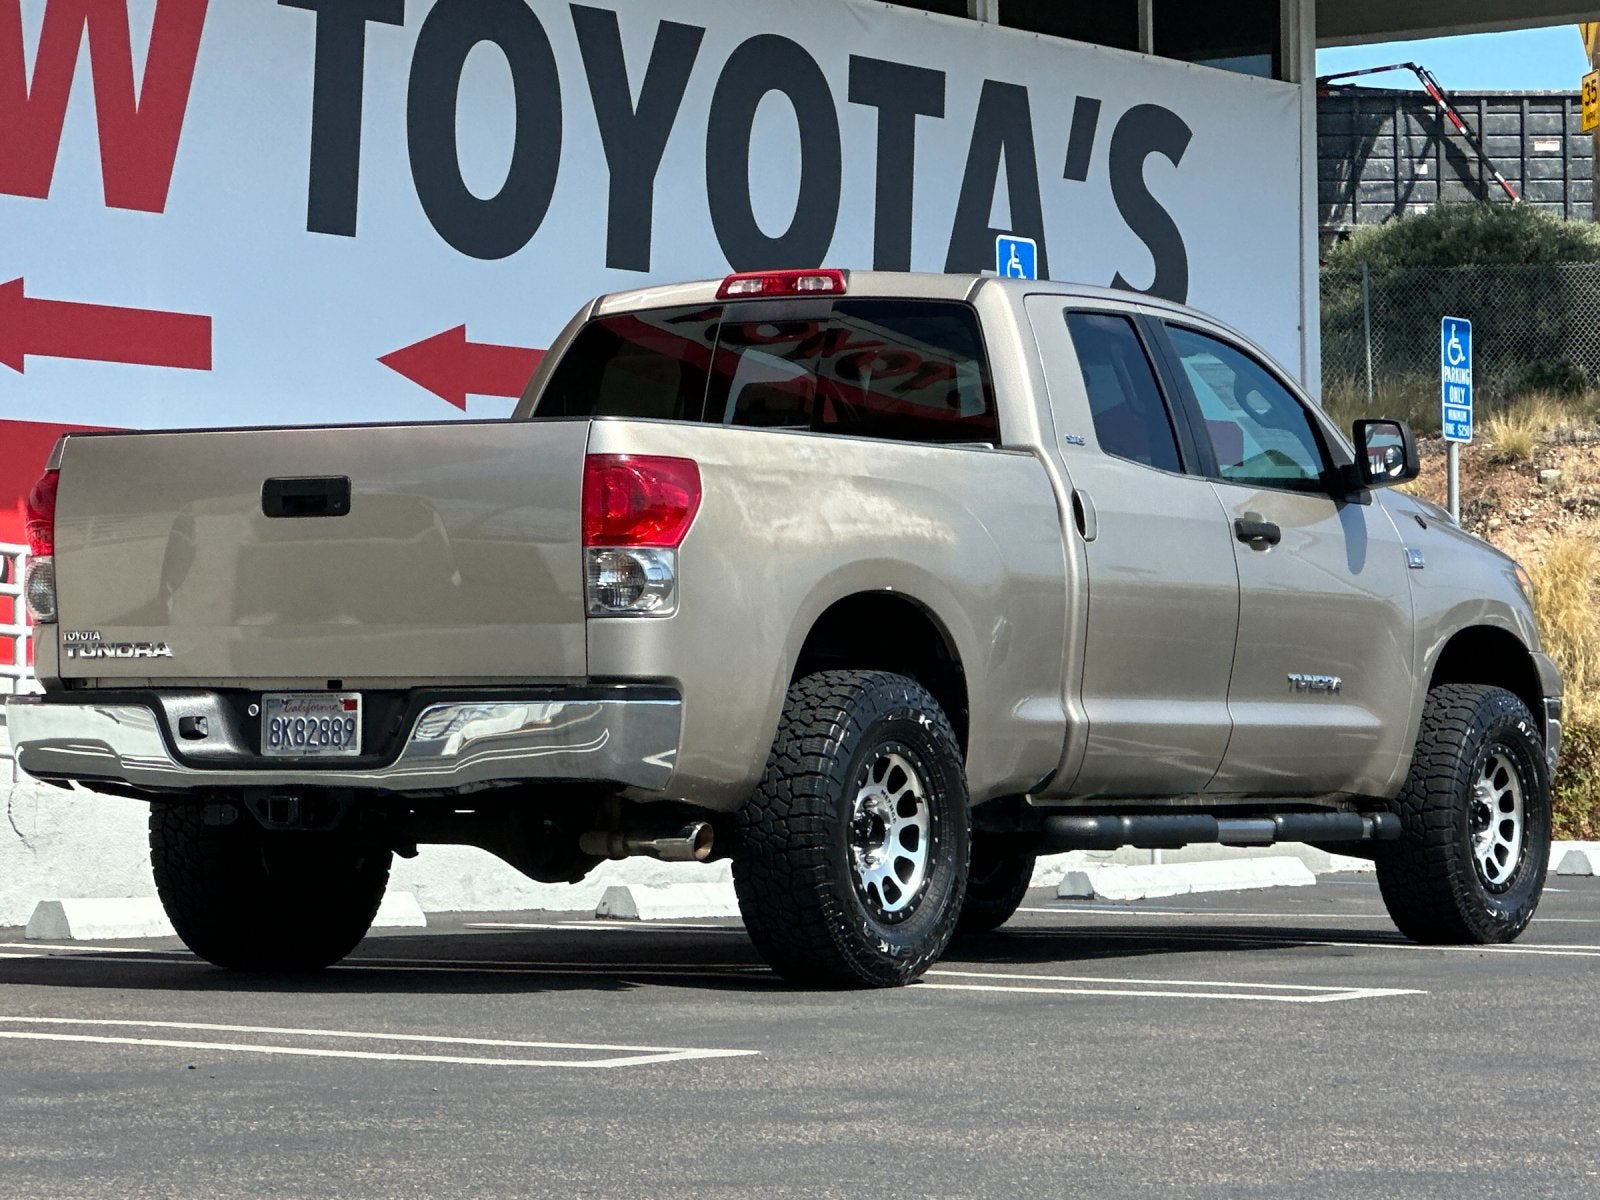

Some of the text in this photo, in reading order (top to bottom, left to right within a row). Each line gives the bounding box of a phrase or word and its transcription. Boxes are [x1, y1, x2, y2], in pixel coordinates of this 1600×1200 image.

[1585, 79, 1597, 106] 35
[278, 0, 1192, 305] TOYOTA'S
[1445, 366, 1470, 385] PARKING
[1449, 385, 1465, 404] ONLY
[63, 631, 101, 641] TOYOTA
[63, 642, 174, 659] TUNDRA
[283, 700, 340, 715] California
[270, 716, 356, 747] 8K82889
